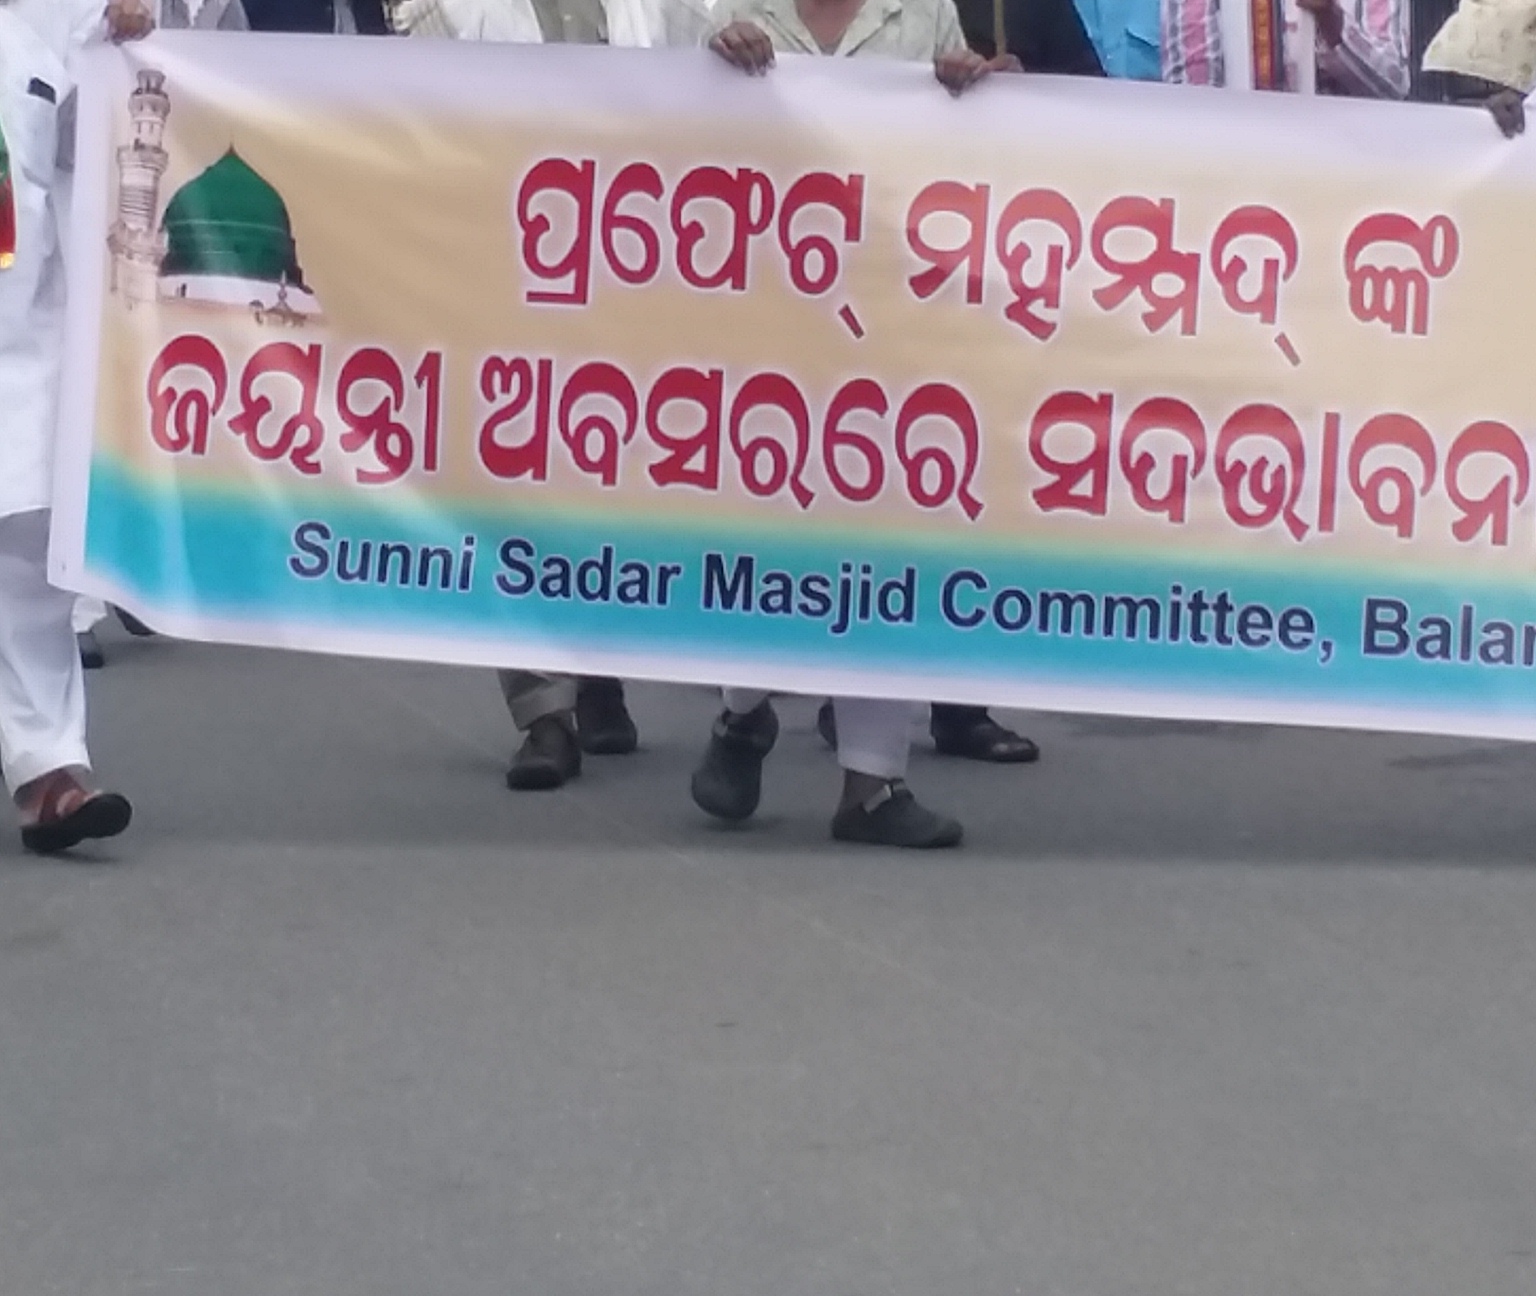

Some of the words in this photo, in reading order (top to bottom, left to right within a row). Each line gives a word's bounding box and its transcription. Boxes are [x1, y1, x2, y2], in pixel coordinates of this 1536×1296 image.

[516, 157, 865, 339] ପ୍ରଫେଟ୍
[905, 179, 1301, 367] ମହମ୍ମଦ୍
[147, 334, 442, 485] ଜୟନ୍ତୀ
[478, 355, 984, 521] ଅବସରରେ
[289, 521, 476, 593] Sunni
[495, 537, 681, 606] Sadar
[702, 553, 916, 635] Masjid
[942, 569, 1334, 663] Committee,
